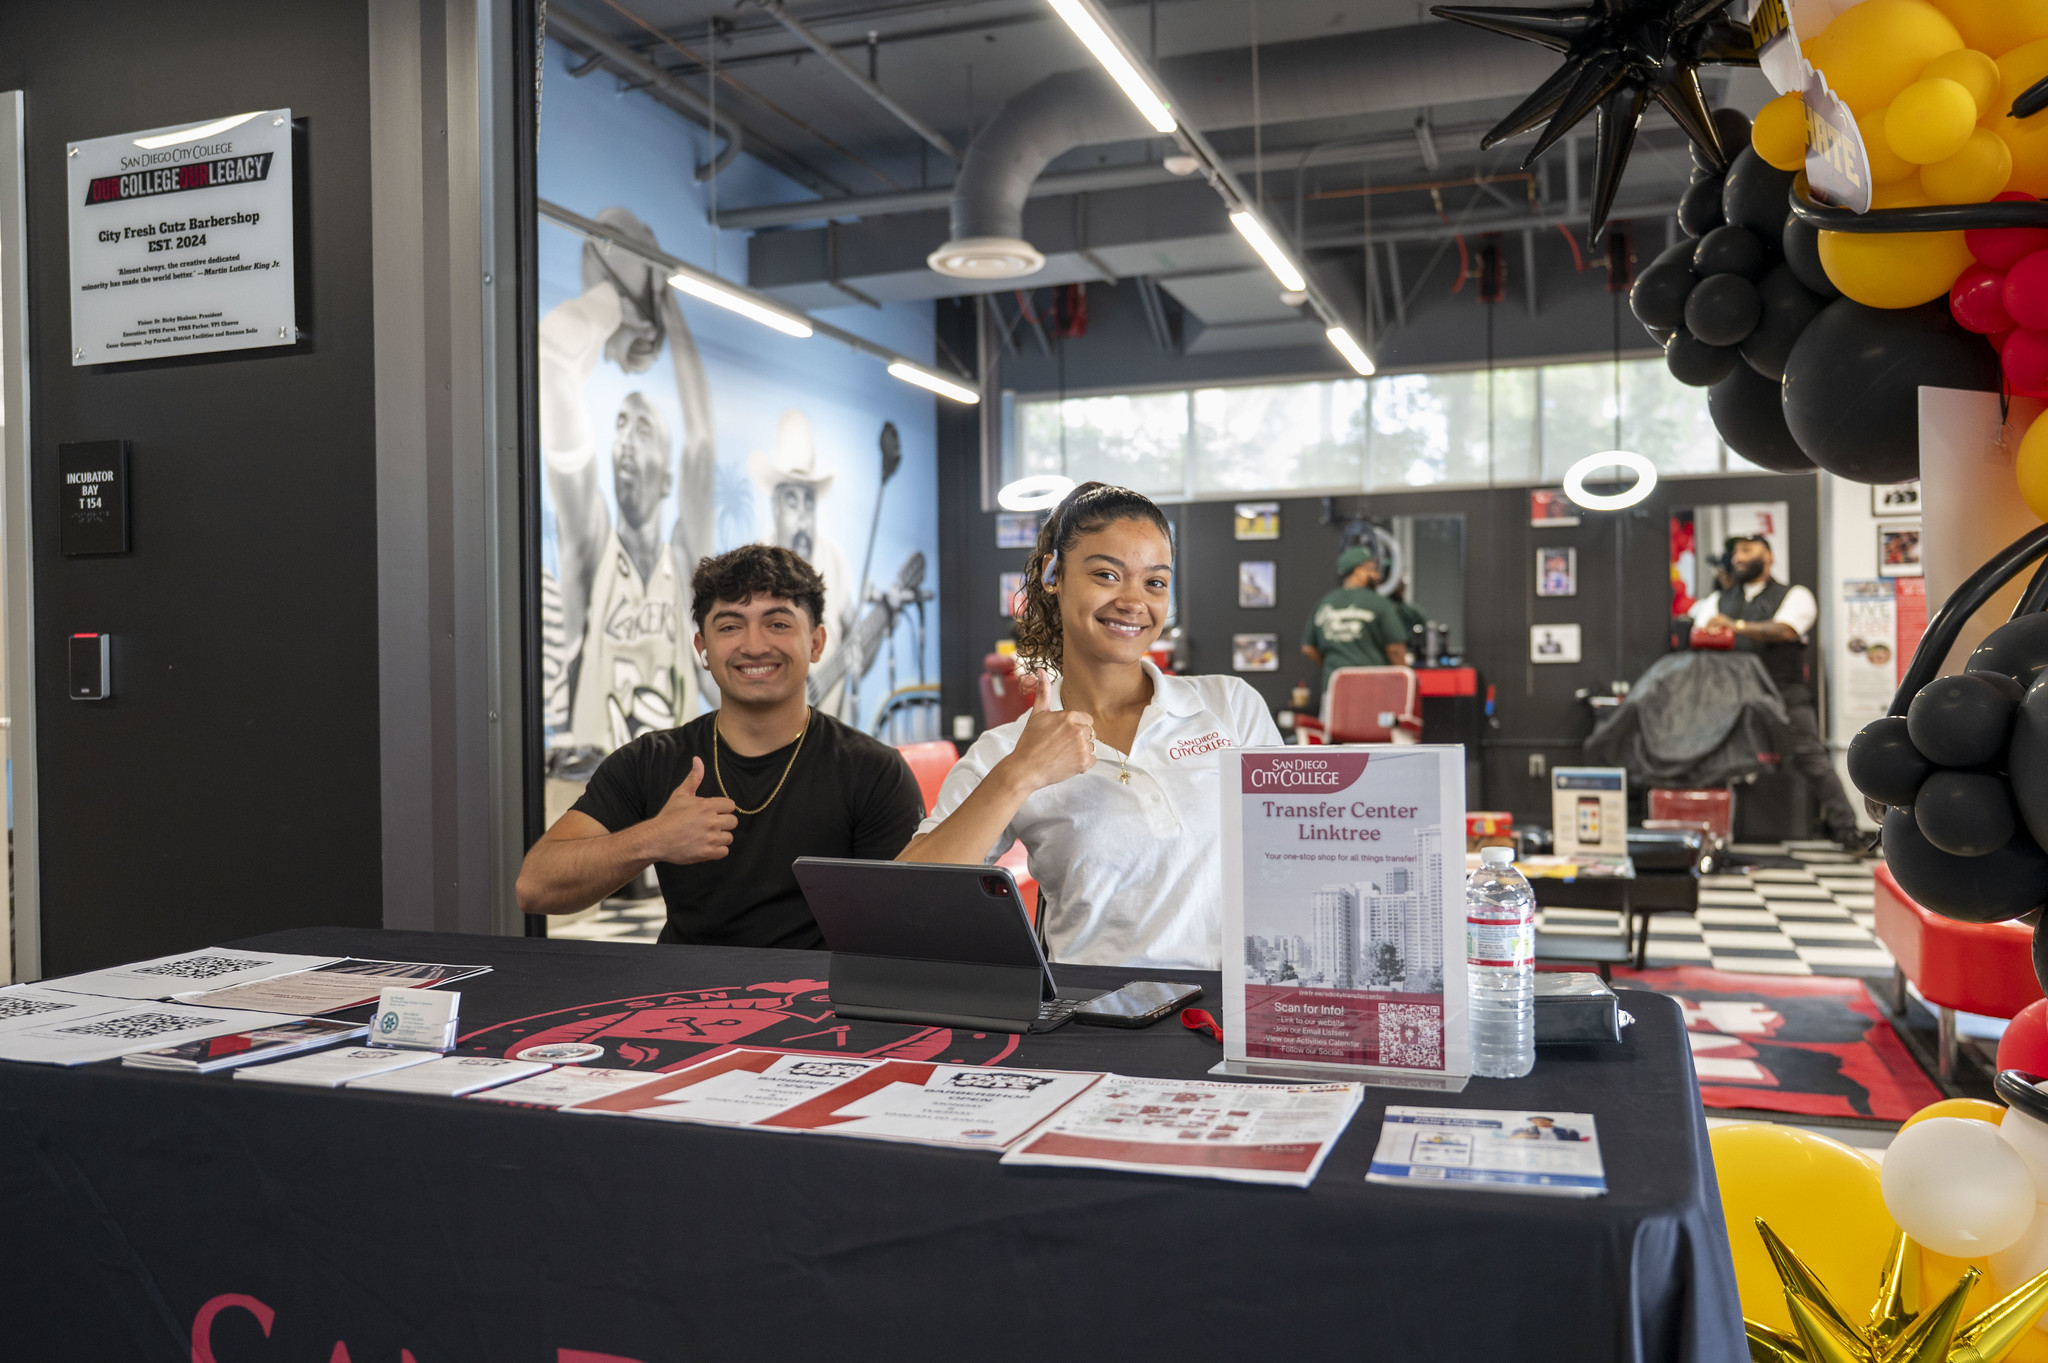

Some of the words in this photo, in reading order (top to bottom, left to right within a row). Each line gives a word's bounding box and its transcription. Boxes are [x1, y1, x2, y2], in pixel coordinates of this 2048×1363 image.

[1800, 99, 1861, 189] HATE
[121, 156, 140, 171] SAN
[141, 152, 172, 167] DIEGO
[98, 230, 121, 243] City
[124, 224, 156, 239] Fresh
[159, 220, 186, 234] Cutz
[189, 211, 260, 231] Barbershop
[148, 240, 174, 253] EST.
[176, 233, 207, 249] 2024
[167, 261, 178, 269] the
[180, 258, 207, 268] creative
[208, 253, 240, 264] dedicated
[81, 281, 108, 291] minority
[110, 280, 120, 288] has
[122, 277, 139, 286] made
[152, 273, 171, 282] world
[229, 264, 252, 273] Luther
[254, 262, 271, 270] King
[66, 470, 114, 484] INCUBATOR
[82, 484, 99, 496] BAY
[79, 498, 85, 509] T
[87, 497, 102, 509] 154
[1177, 739, 1195, 748] SAN
[1195, 731, 1219, 746] DIEGO
[1169, 747, 1191, 760] CITY
[1272, 758, 1293, 770] SAN
[1294, 759, 1328, 770] DIEGO
[1251, 768, 1281, 787] CITY
[1280, 769, 1340, 787] COLLEGE
[1262, 801, 1346, 818] Transfer
[1351, 801, 1418, 819] Center
[1298, 824, 1381, 842] Linktree
[1264, 852, 1282, 861] Your
[1283, 853, 1316, 862] one-stop
[1318, 853, 1336, 863] shop
[1337, 853, 1349, 861] for
[1350, 853, 1359, 862] all
[1360, 854, 1384, 863] things
[1385, 854, 1418, 863] transfer!
[624, 992, 728, 1008] SAN
[1274, 1002, 1301, 1013] Scan
[1303, 1003, 1318, 1014] for
[1321, 1004, 1345, 1016] Info!
[1318, 1019, 1345, 1028] website
[1302, 1027, 1321, 1035] Email
[1322, 1029, 1350, 1038] Listserv
[1296, 1036, 1327, 1046] Activities
[1328, 1038, 1360, 1048] Calendar
[1318, 1048, 1344, 1057] Socials
[1185, 1081, 1253, 1089] CAMPUS
[1258, 1083, 1352, 1091] DIRECTORY
[924, 1088, 1031, 1099] BARBERSHOP
